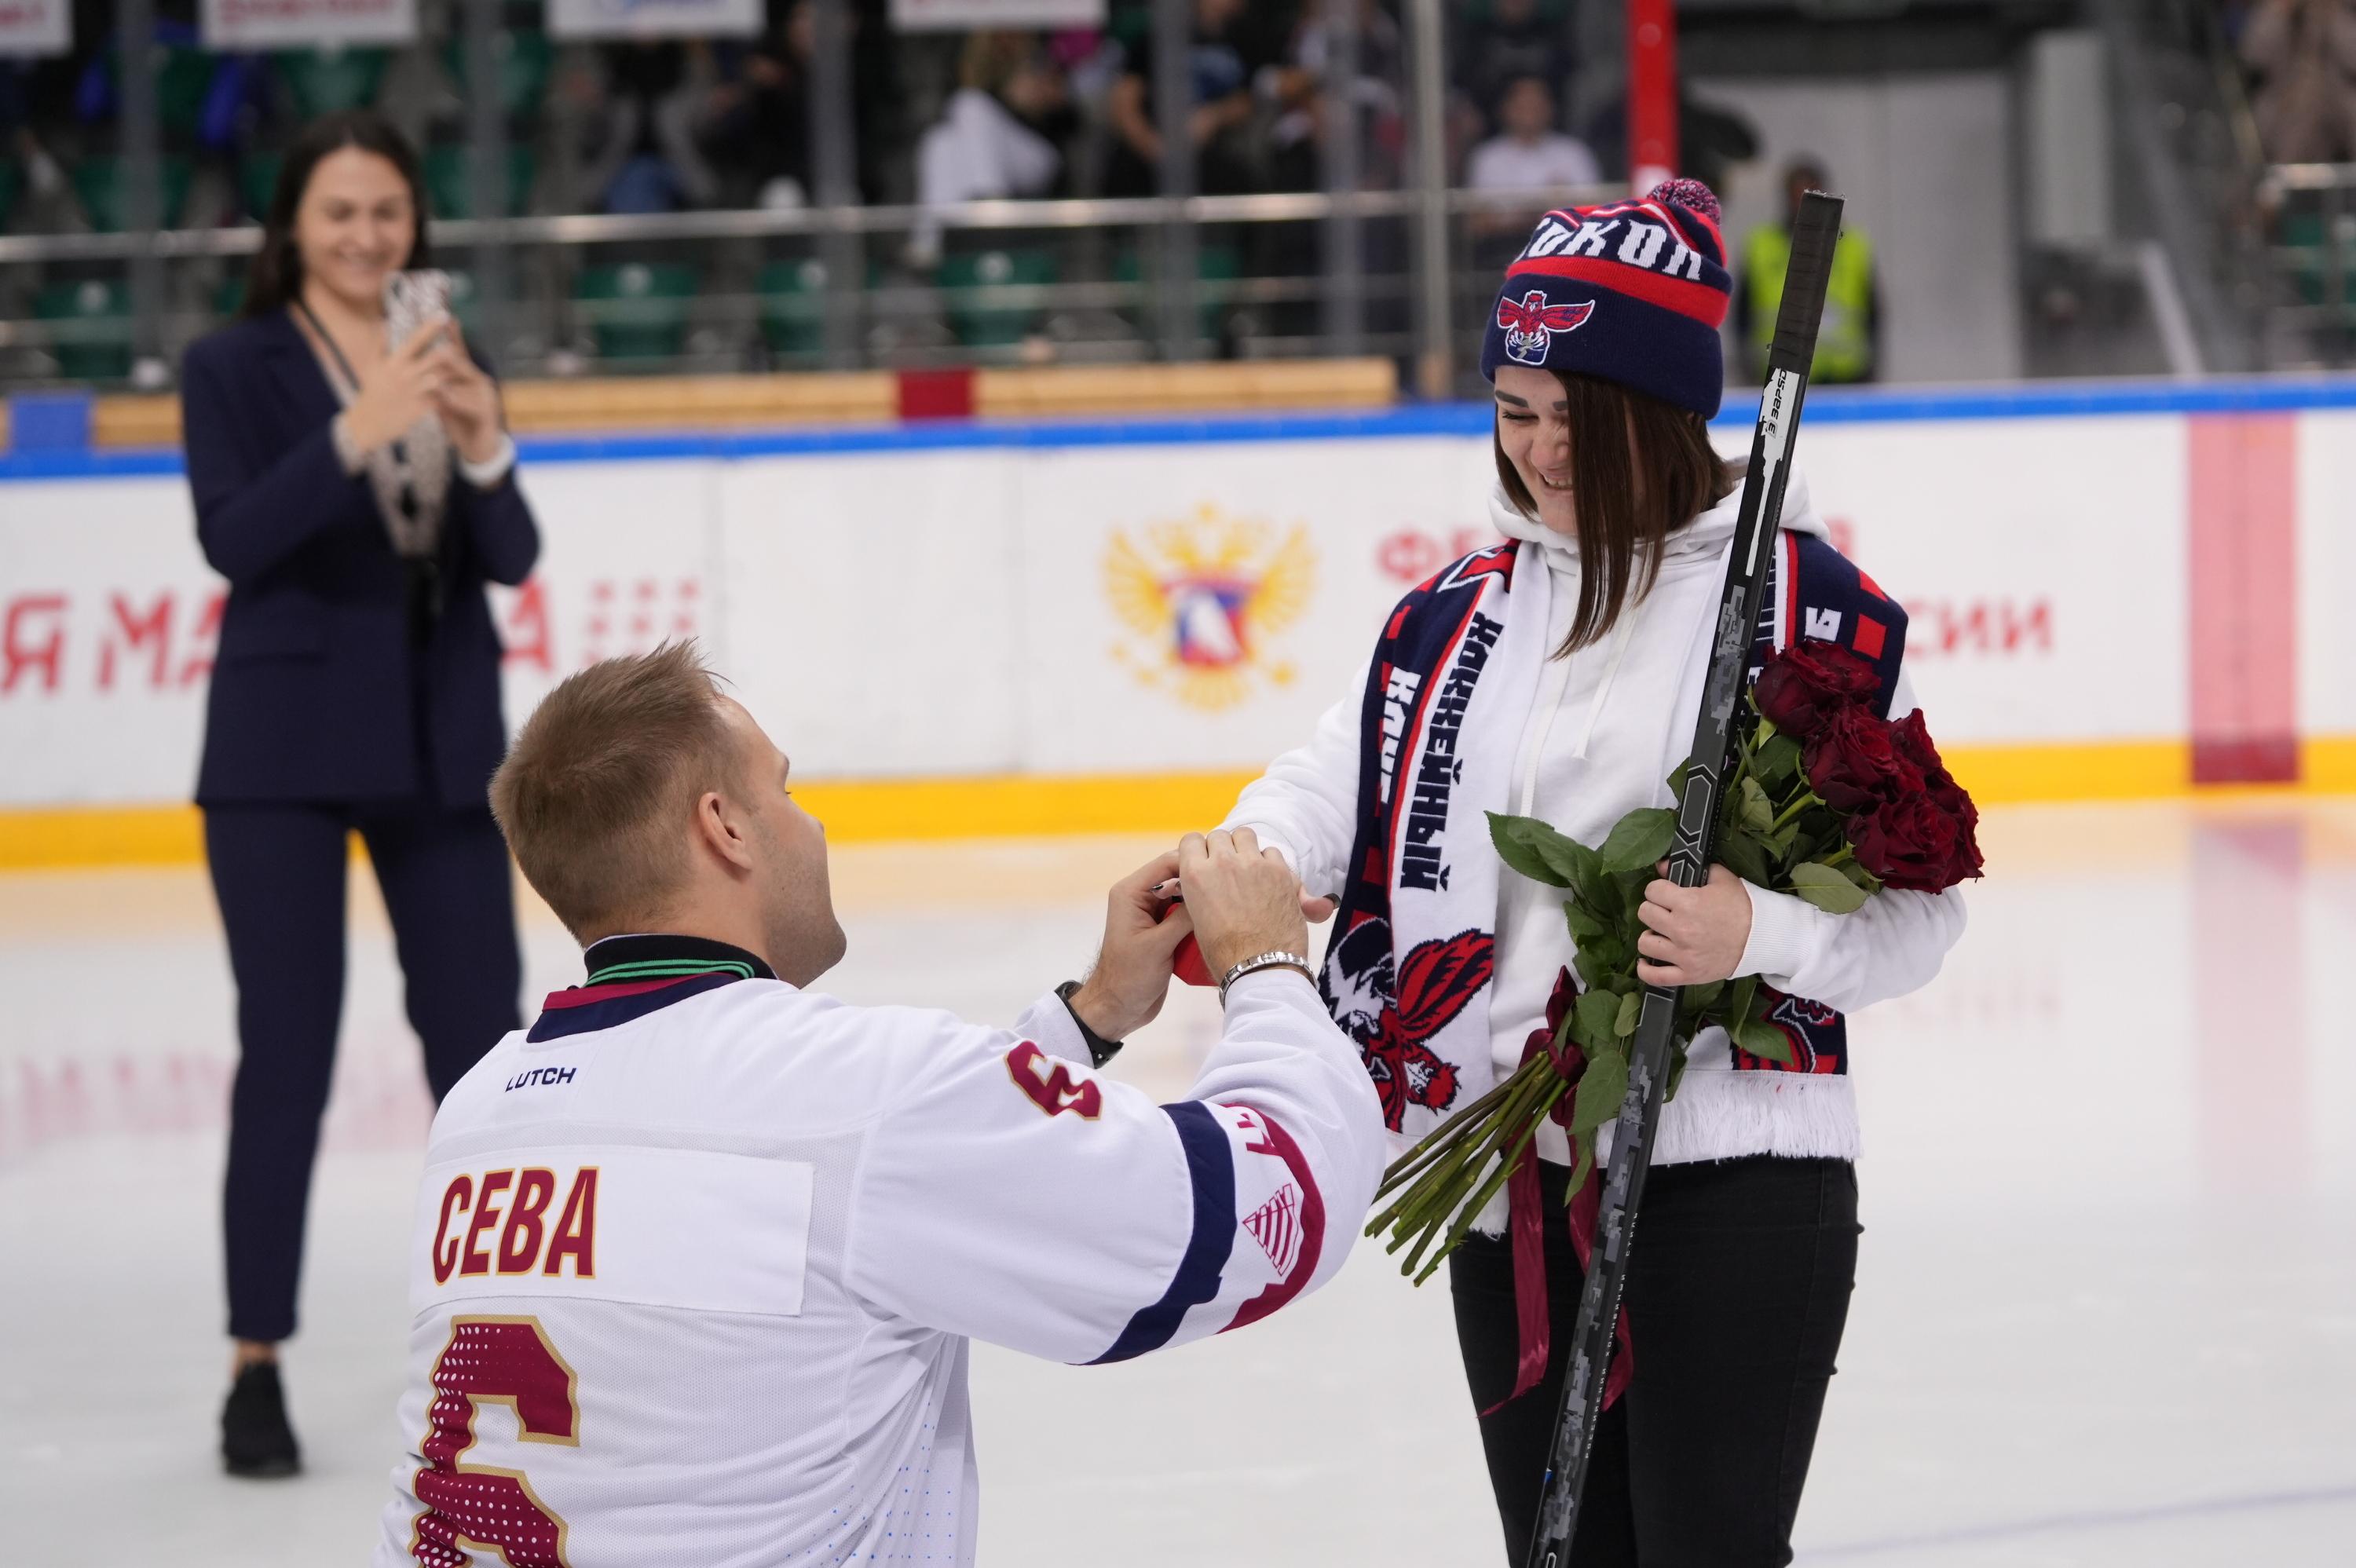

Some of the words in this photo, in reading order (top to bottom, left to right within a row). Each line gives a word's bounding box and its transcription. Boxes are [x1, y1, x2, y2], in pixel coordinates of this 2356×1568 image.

[1399, 611, 1505, 892] ХОККЕЙНЫЙ
[505, 1067, 576, 1093] LUTCH
[433, 1166, 600, 1286] СЕВА
